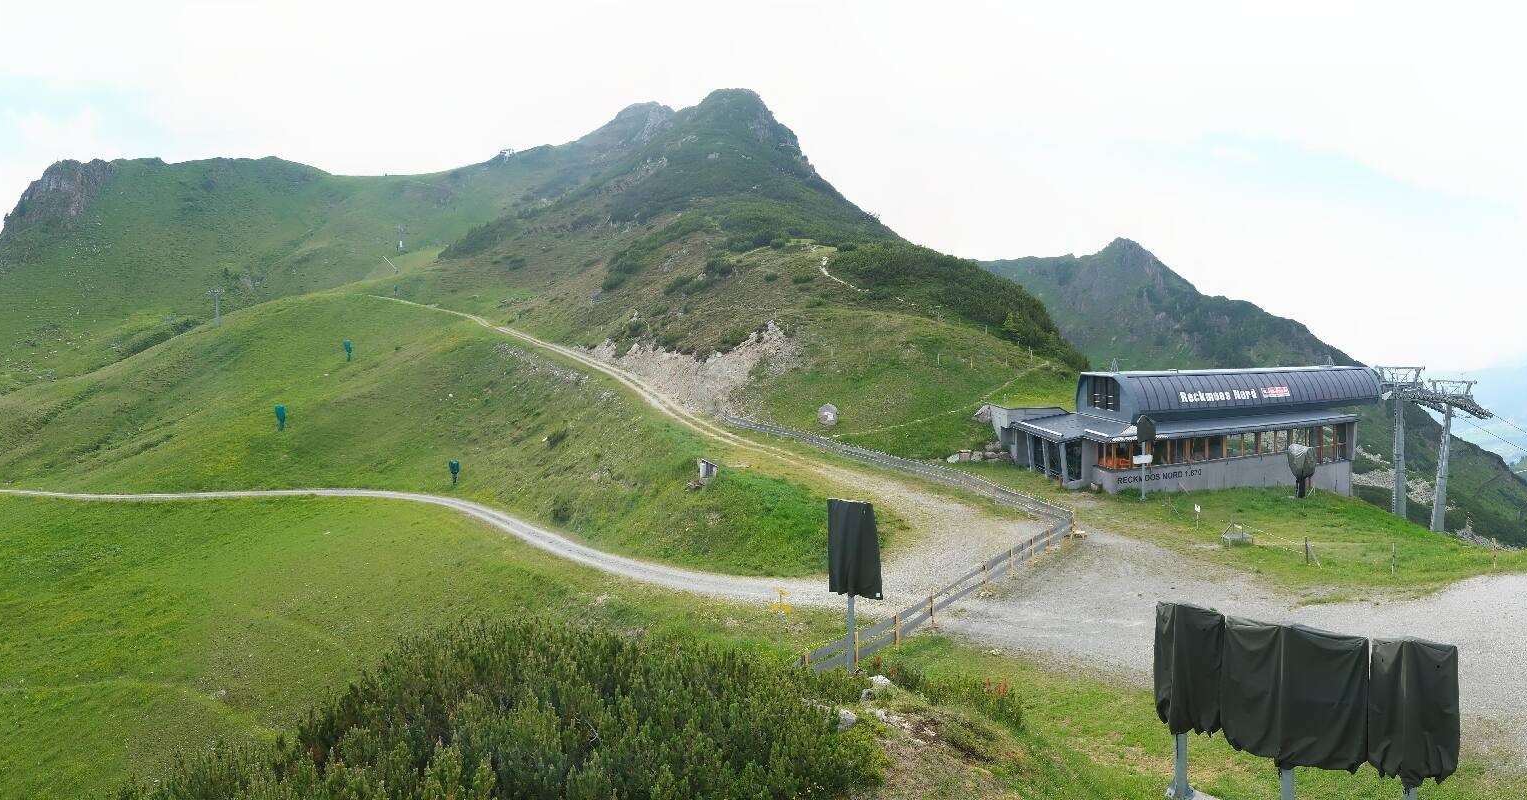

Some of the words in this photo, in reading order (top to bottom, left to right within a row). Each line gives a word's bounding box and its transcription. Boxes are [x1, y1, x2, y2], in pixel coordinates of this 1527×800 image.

[1180, 391, 1231, 402] Reckmoos
[1232, 389, 1257, 400] Nord
[1162, 470, 1183, 480] NORD
